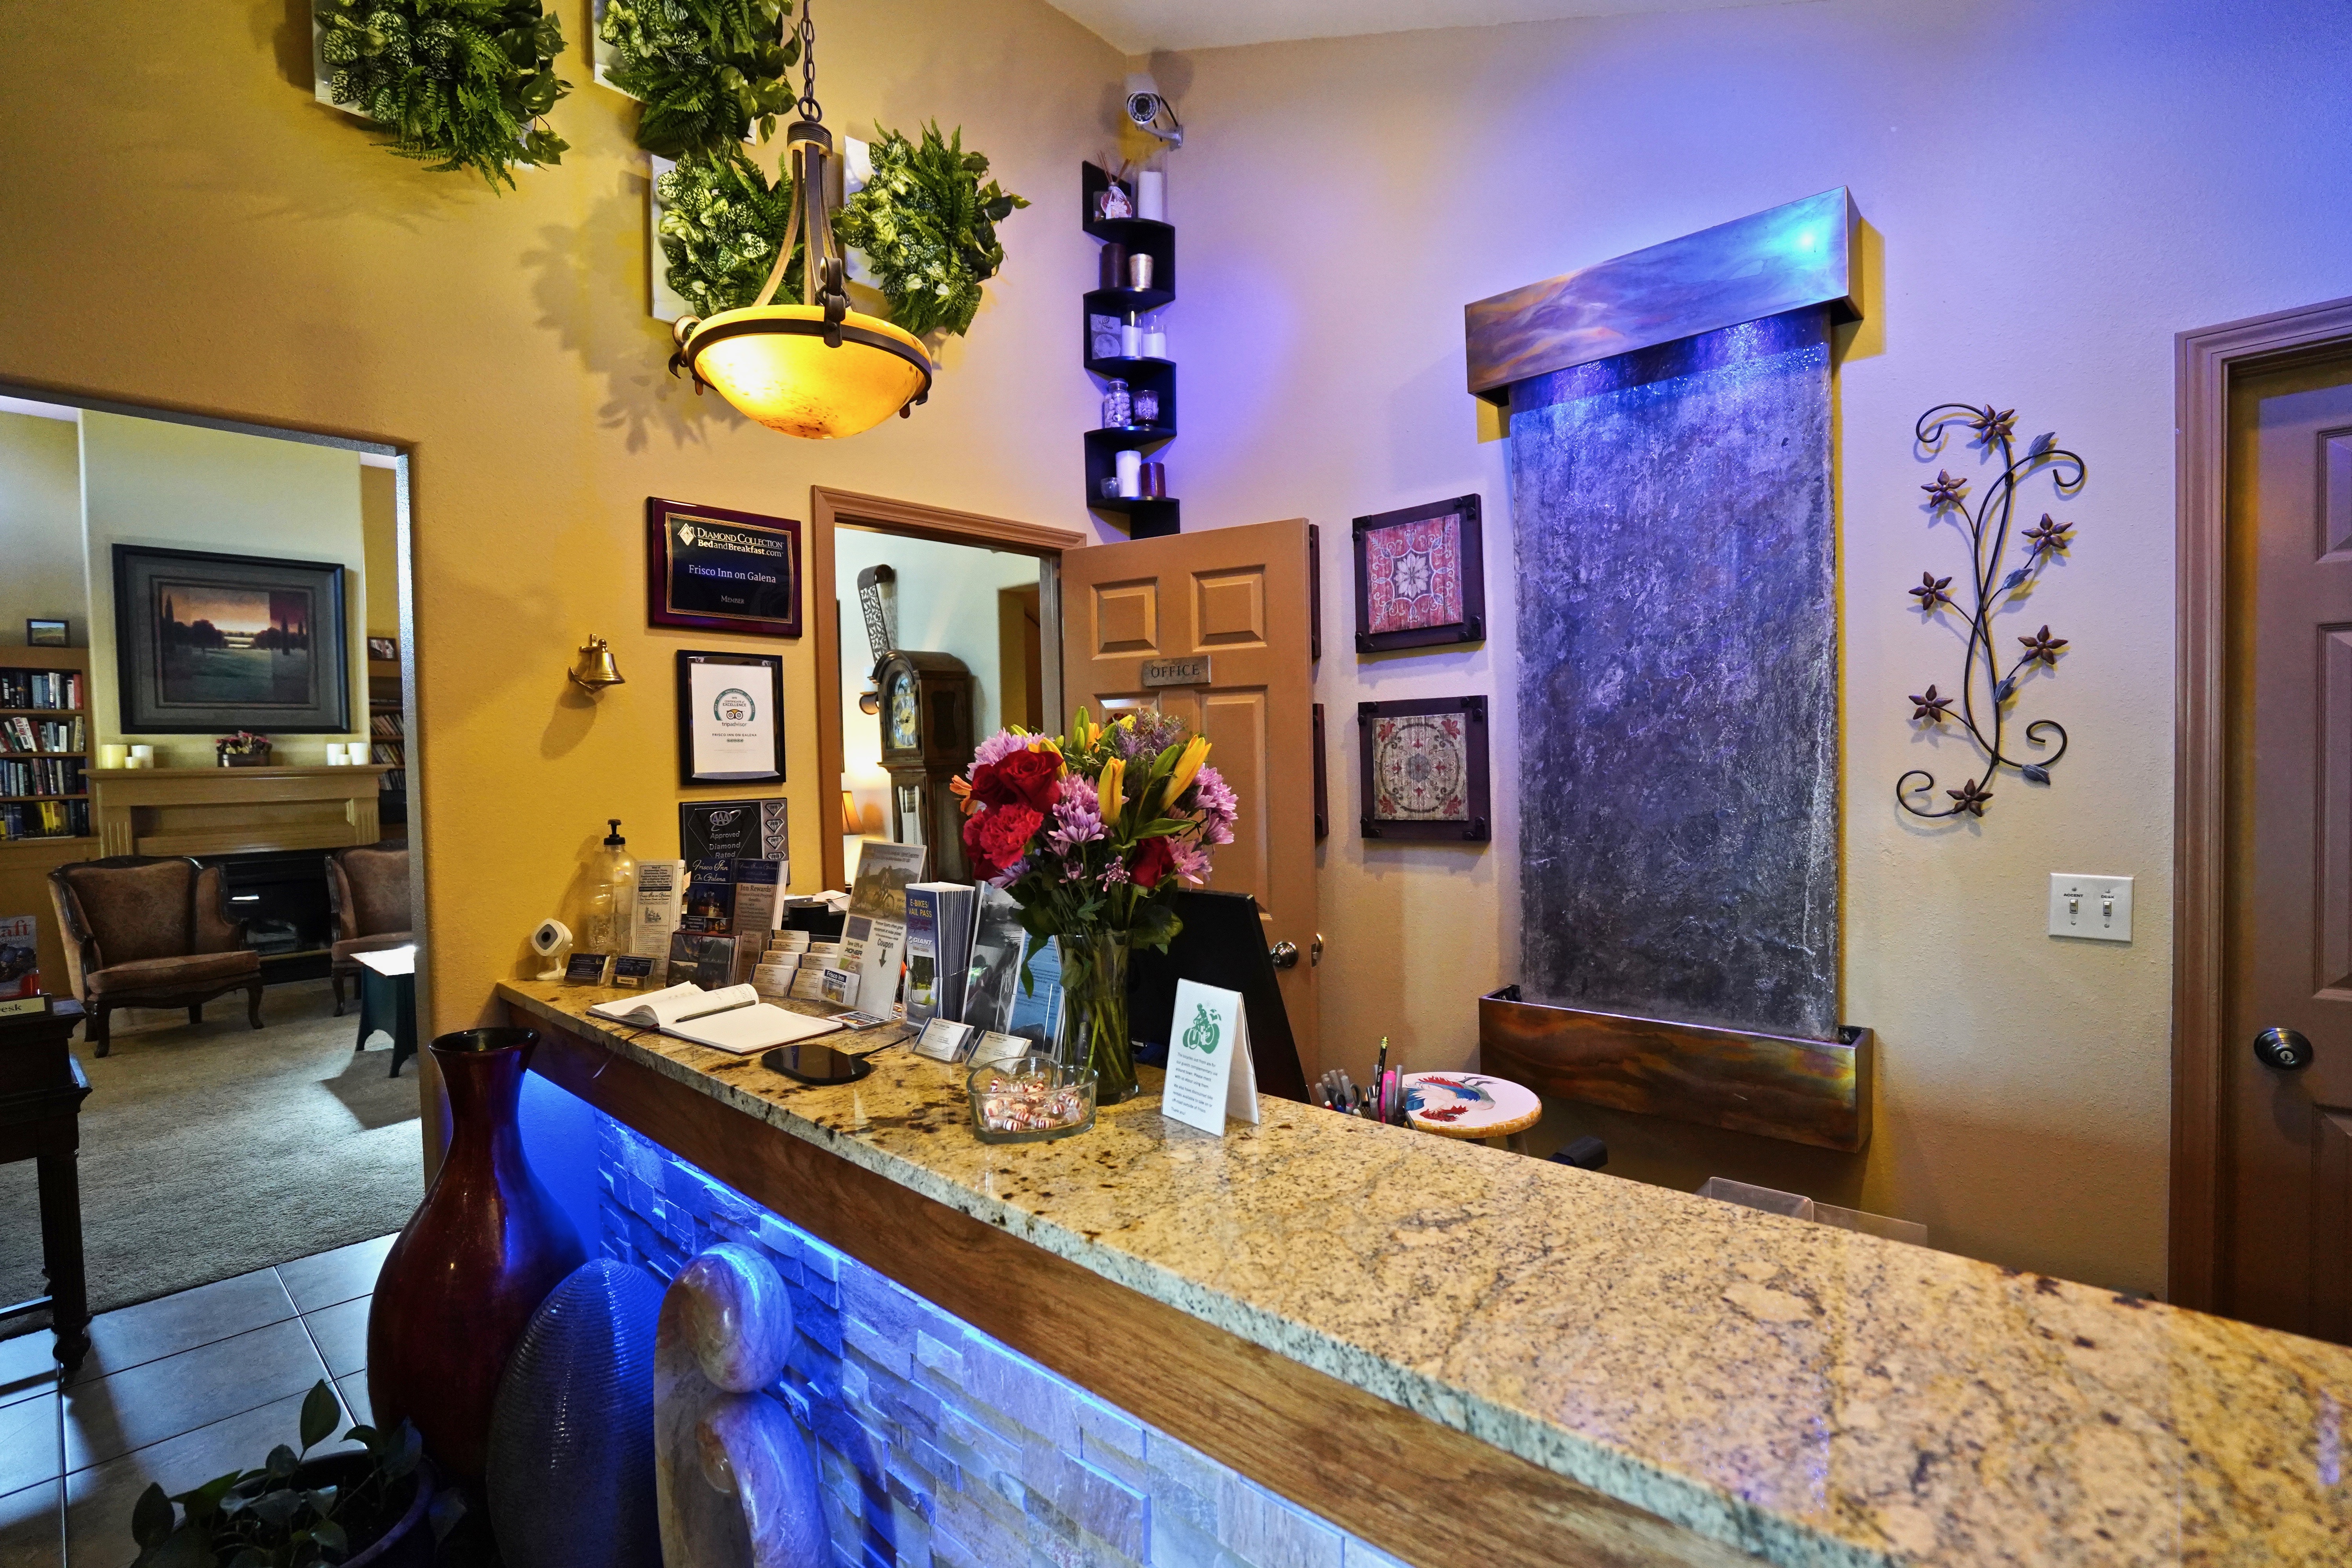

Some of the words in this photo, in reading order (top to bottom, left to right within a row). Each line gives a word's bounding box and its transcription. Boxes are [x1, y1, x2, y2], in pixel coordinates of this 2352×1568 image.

[697, 527, 736, 542] DIAMOND
[698, 539, 782, 557] BedandBreakfast.com
[689, 565, 715, 576] Frisco
[717, 568, 732, 578] Inn
[748, 572, 776, 583] Galena
[721, 595, 744, 604] MEMBER
[1151, 664, 1200, 678] OFFICE
[712, 812, 730, 823] AAA
[710, 831, 740, 840] Approved
[693, 860, 712, 870] Frisco
[714, 860, 728, 871] Inn
[910, 899, 929, 908] E-BIKES/
[908, 907, 918, 916] VAIL
[920, 909, 932, 918] PASS
[877, 938, 893, 949] Coupon
[913, 937, 933, 946] GIANT
[827, 971, 838, 979] Frisco
[0, 1004, 22, 1012] esk
